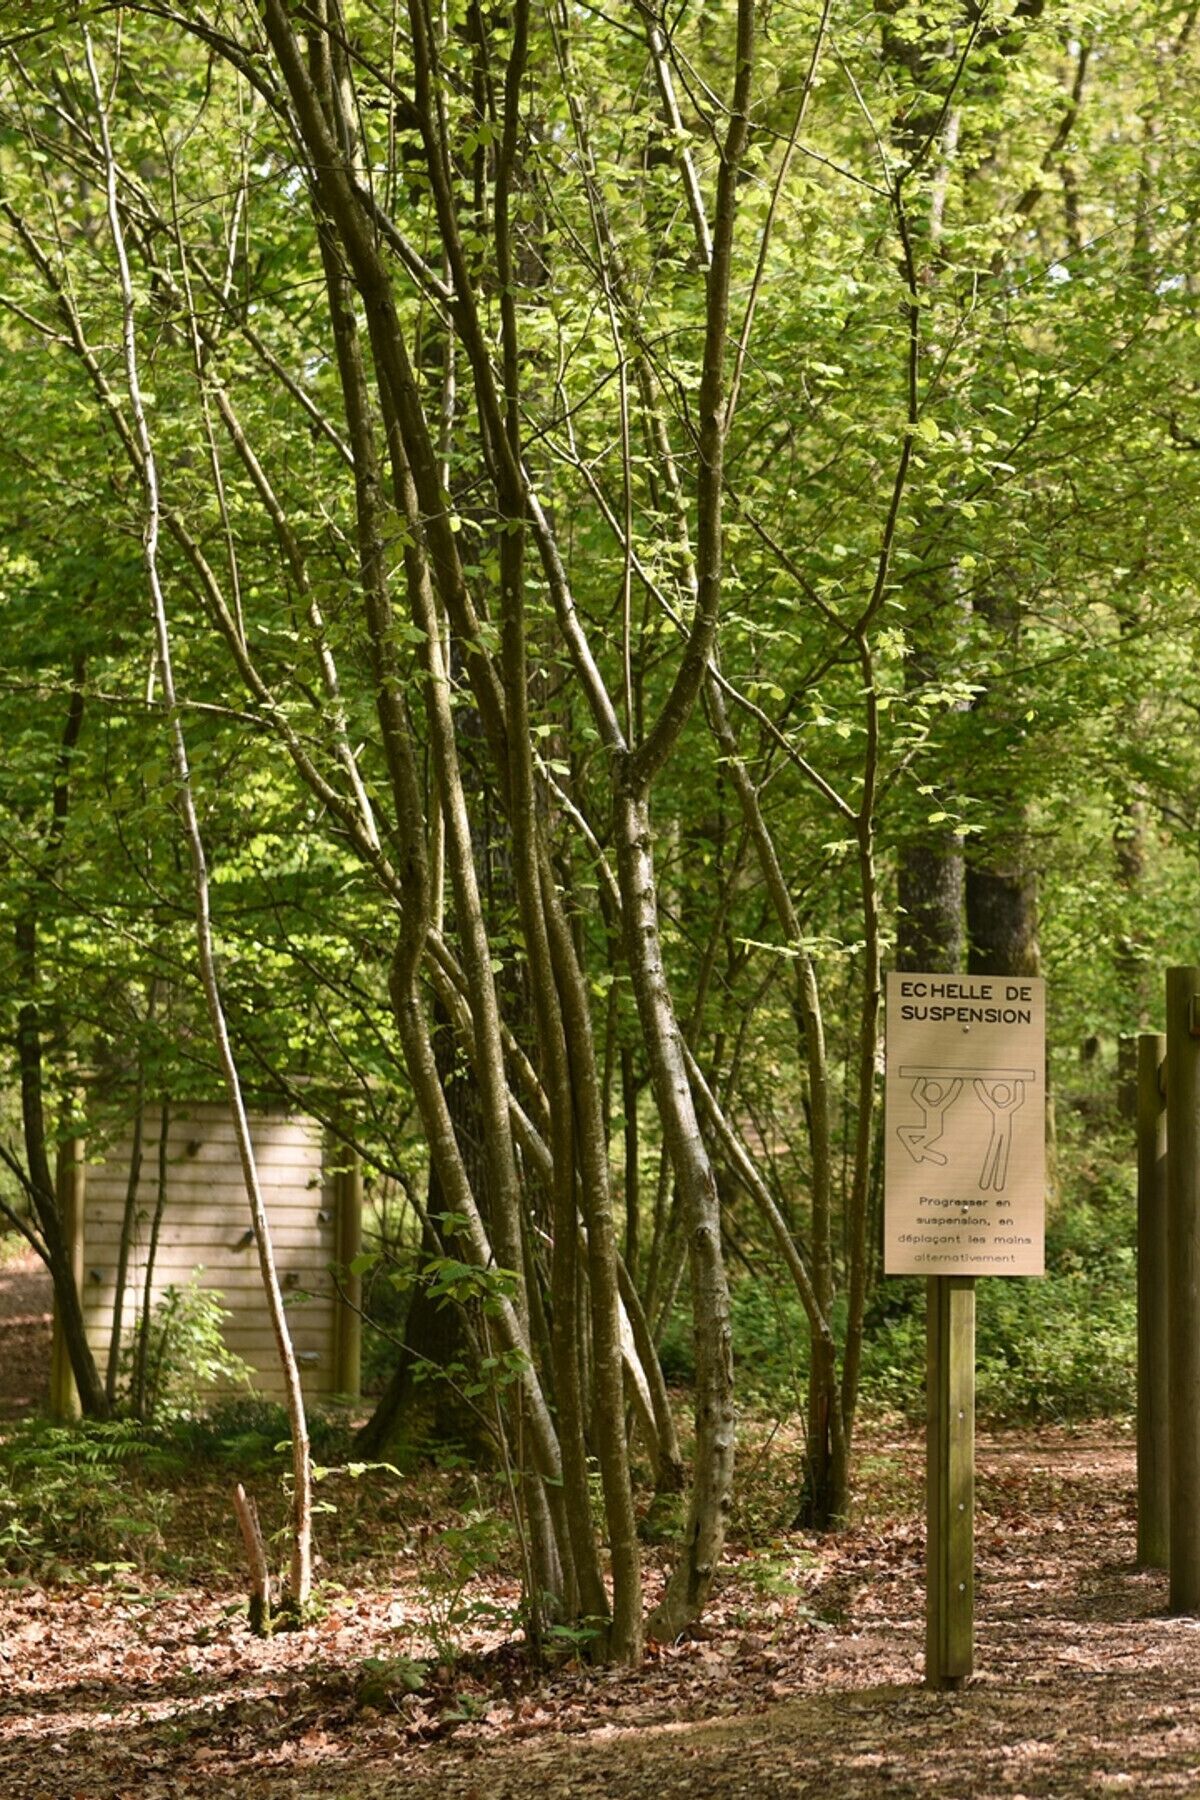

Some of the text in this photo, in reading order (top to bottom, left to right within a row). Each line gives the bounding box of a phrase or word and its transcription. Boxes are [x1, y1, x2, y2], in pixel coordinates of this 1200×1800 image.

[901, 982, 1032, 1001] ECHELLE DE
[901, 1005, 1031, 1024] SUSPENSION
[919, 1197, 988, 1208] Progresser
[916, 1217, 991, 1227] suspension,
[898, 1234, 1032, 1245] déplaçant les mains
[914, 1253, 1016, 1263] alternativement
